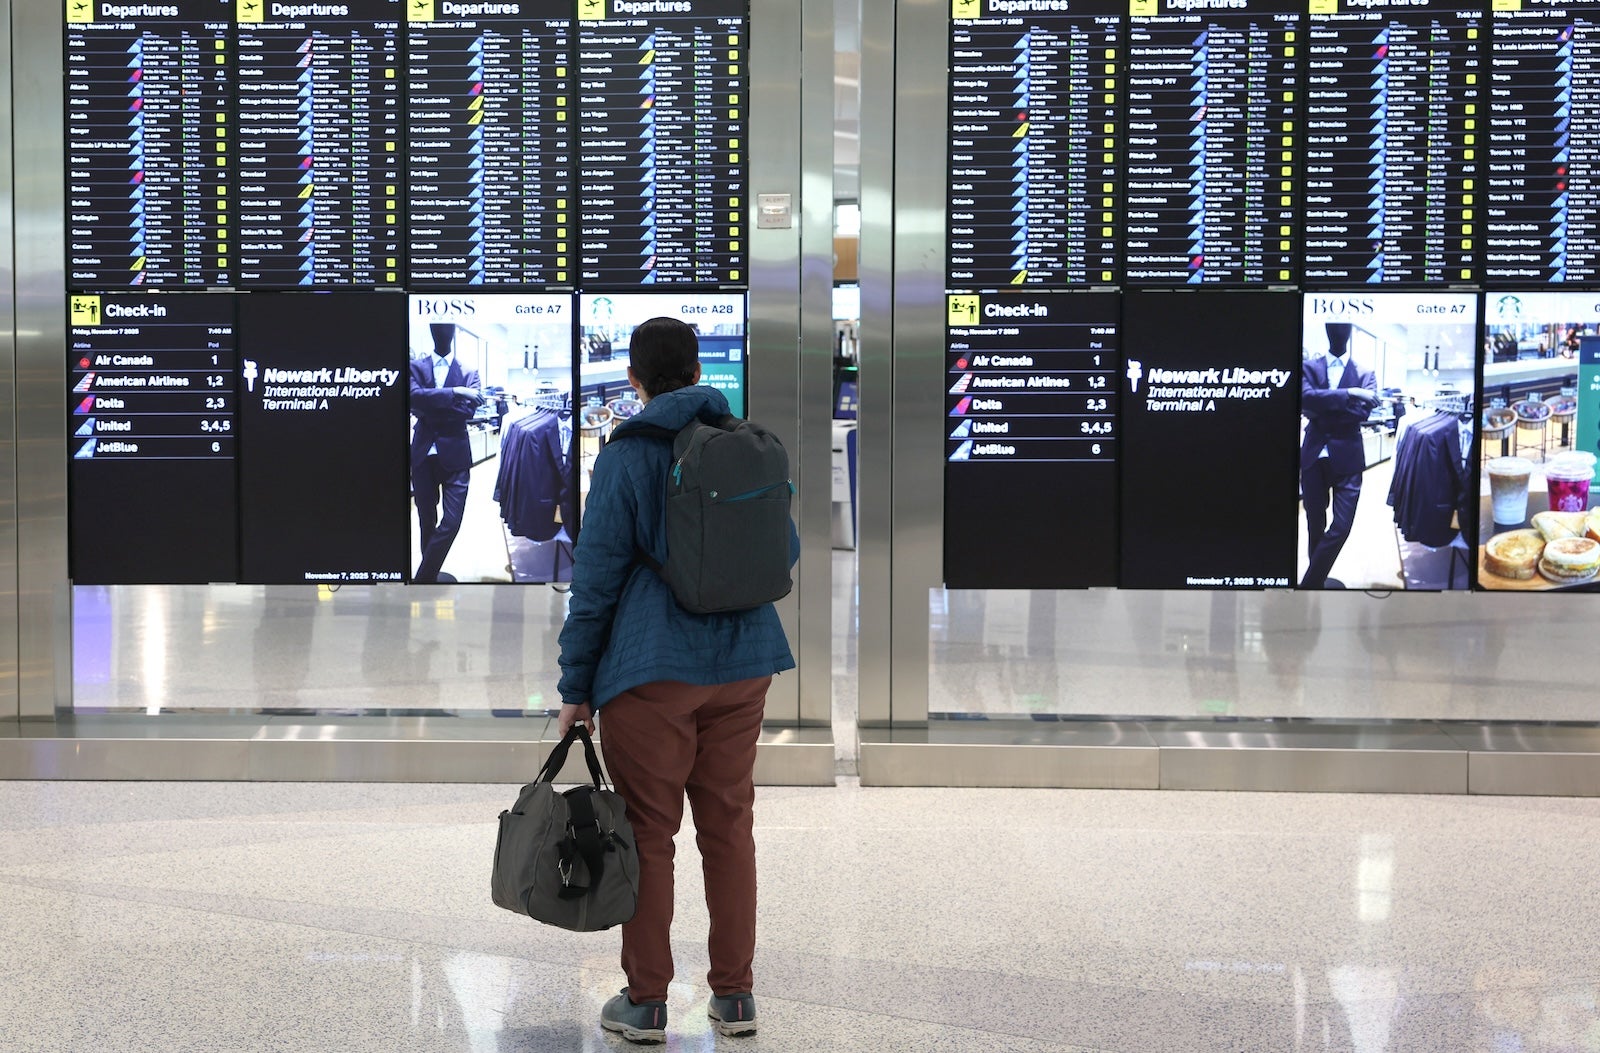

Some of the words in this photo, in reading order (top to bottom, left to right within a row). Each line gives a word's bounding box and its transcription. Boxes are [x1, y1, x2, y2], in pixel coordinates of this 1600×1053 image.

[102, 4, 178, 18] Departures
[272, 3, 348, 18] Departures
[443, 3, 519, 17] Departures
[613, 1, 691, 15] Departures
[989, 0, 1068, 14] Departures
[105, 304, 166, 317] Check-in
[418, 299, 475, 315] BOSS
[515, 305, 543, 314] Gate
[547, 305, 561, 314] A7
[681, 305, 707, 314] Gate
[711, 305, 733, 314] A28
[984, 303, 1047, 317] Check-in
[1314, 298, 1374, 314] BOSS
[1417, 304, 1446, 314] Gate
[1451, 304, 1466, 313] A7
[95, 355, 112, 366] Air
[113, 355, 153, 366] Canada
[211, 355, 218, 365] 1
[973, 355, 990, 366] Air
[991, 355, 1033, 366] Canada
[1094, 355, 1100, 366] 1
[95, 376, 146, 386] American
[148, 376, 189, 386] Airlines
[206, 376, 223, 388] 1,2
[264, 368, 333, 383] Newark
[334, 367, 399, 386] Liberty
[1148, 368, 1220, 384] Newark
[1221, 367, 1291, 387] Liberty
[972, 377, 1025, 388] American
[1027, 377, 1070, 388] Airlines
[1088, 376, 1105, 389] 1,2
[264, 385, 339, 397] International
[341, 386, 381, 399] Airport
[1147, 386, 1228, 398] International
[1228, 386, 1271, 400] Airport
[96, 398, 125, 409] Delta
[206, 398, 225, 410] 2,3
[262, 399, 317, 410] Terminal
[319, 399, 329, 410] A
[972, 400, 1003, 410] Delta
[1086, 399, 1107, 411] 2,3
[1146, 399, 1204, 411] Terminal
[1205, 400, 1216, 411] A
[96, 420, 131, 431] United
[201, 420, 230, 432] 3,4,5
[972, 422, 1008, 433] United
[1080, 422, 1112, 434] 3,4,5
[97, 442, 138, 453] JetBlue
[211, 442, 221, 452] 6
[973, 444, 1016, 455] JetBlue
[1091, 444, 1101, 455] 6
[341, 572, 349, 580] 7,
[1187, 577, 1224, 585] November
[1224, 577, 1233, 586] 7,
[1233, 577, 1254, 585] 2025
[1256, 577, 1274, 586] 7:40
[1275, 577, 1289, 586] AM
